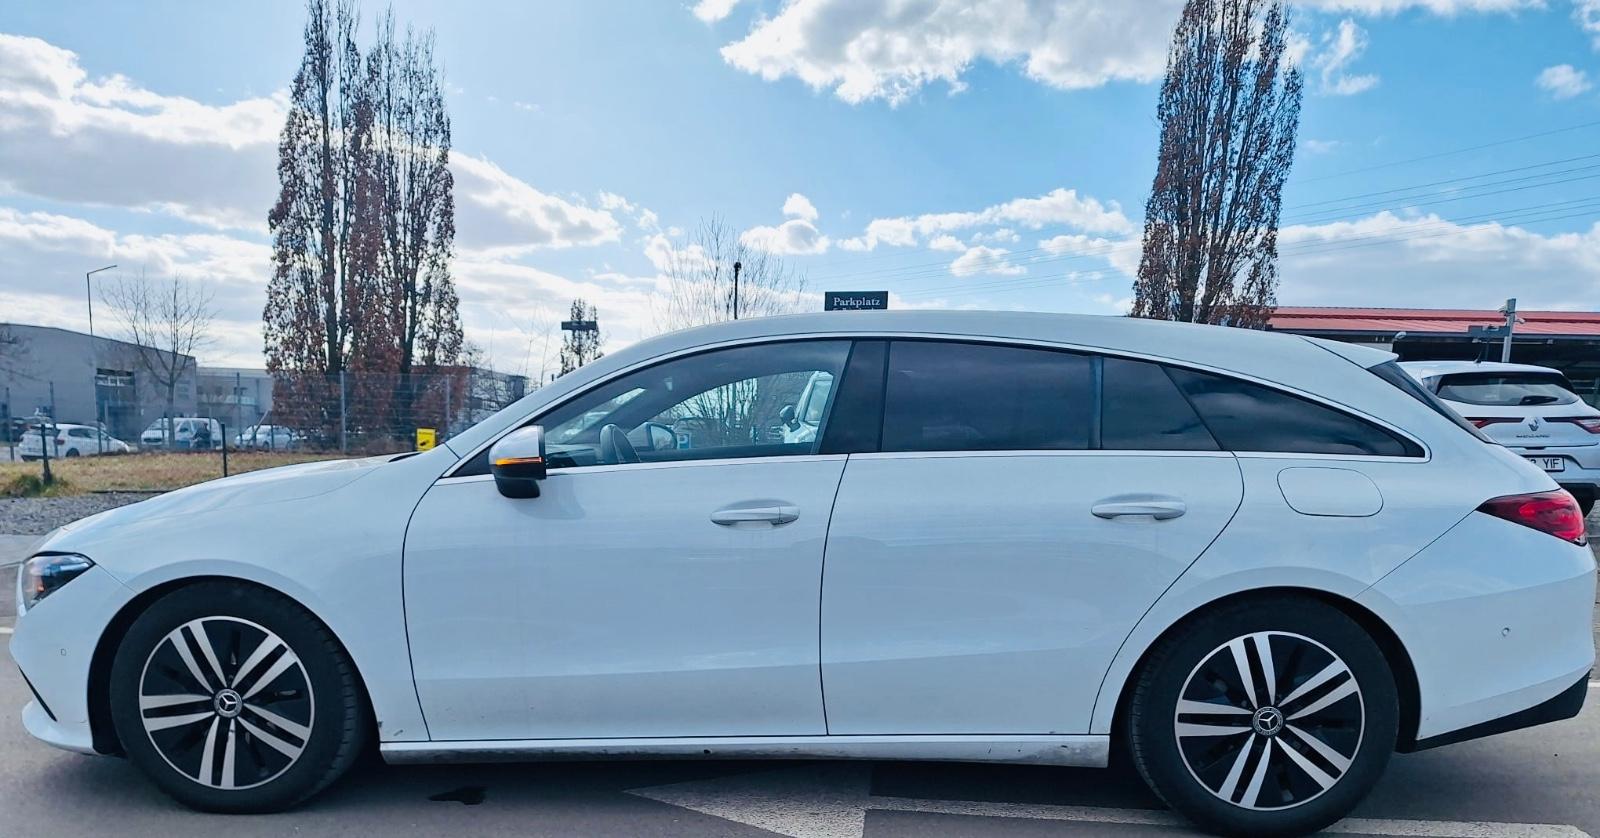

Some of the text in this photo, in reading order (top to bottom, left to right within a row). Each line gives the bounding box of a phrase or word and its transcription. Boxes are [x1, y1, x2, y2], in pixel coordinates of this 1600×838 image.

[833, 297, 880, 308] Parkplatz
[677, 434, 688, 449] P
[1542, 458, 1560, 468] YIF
